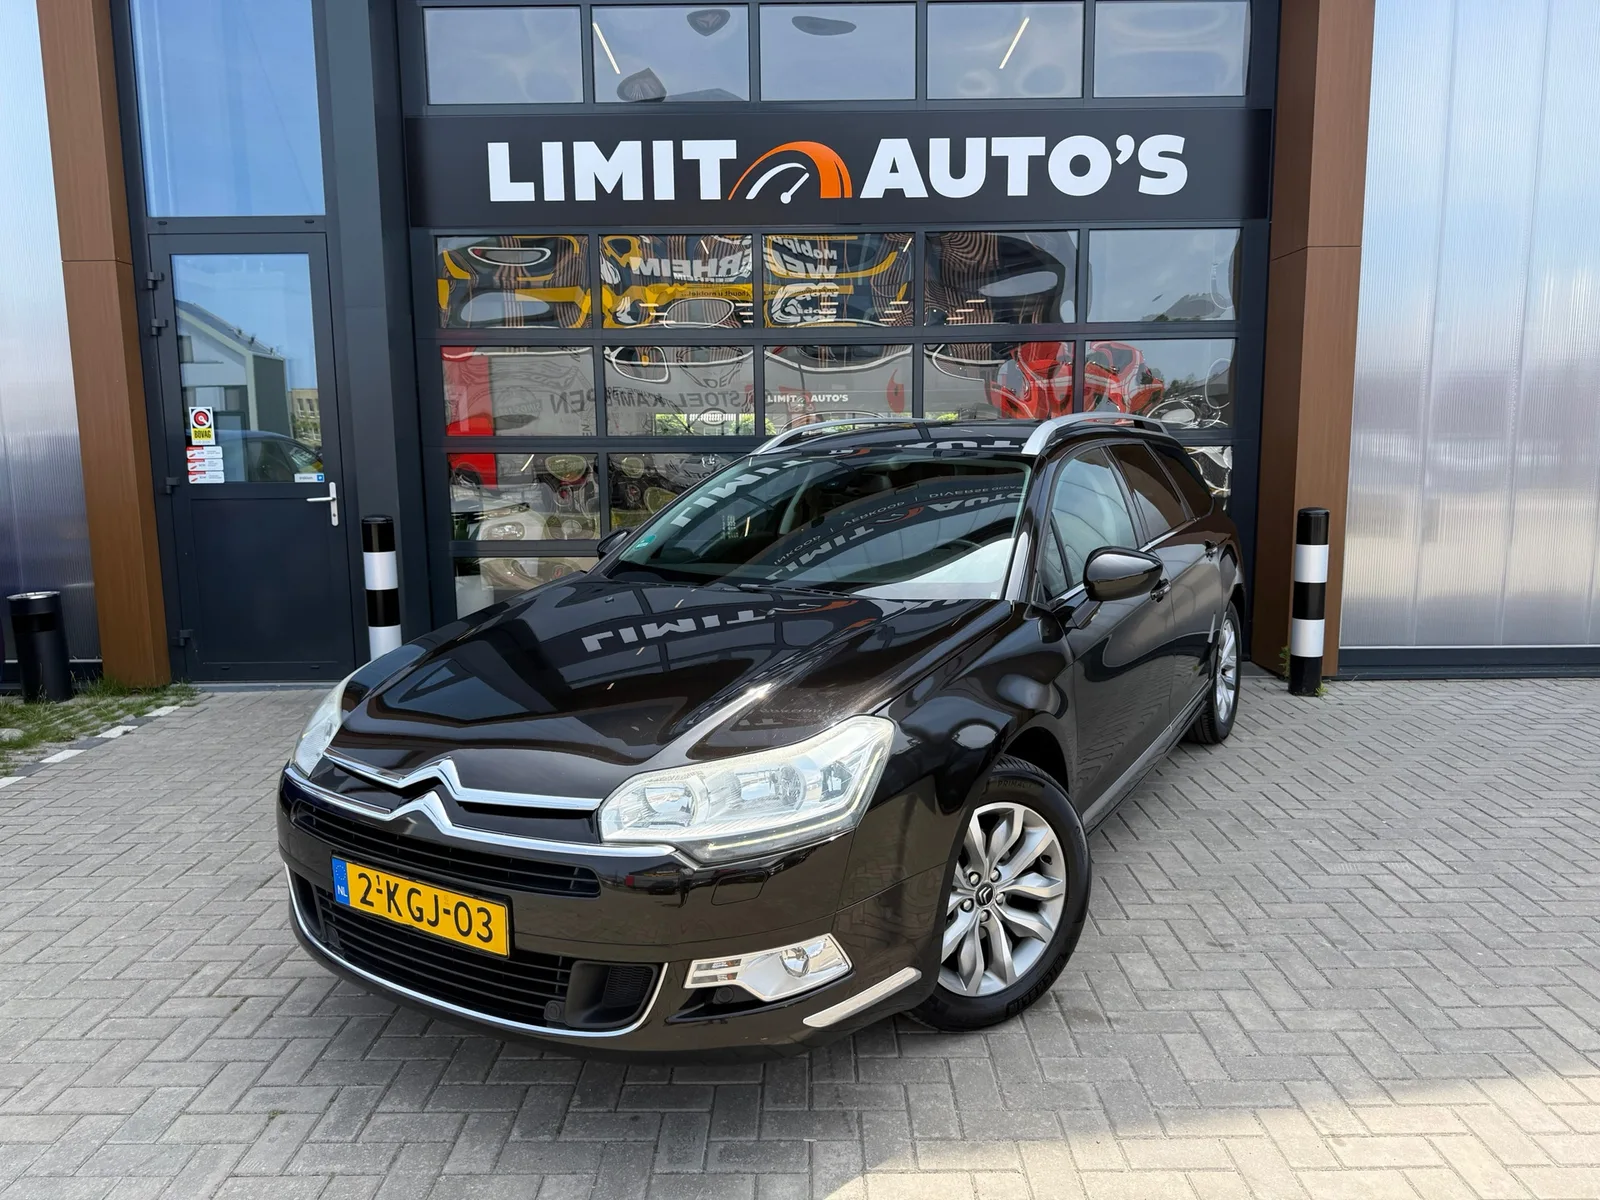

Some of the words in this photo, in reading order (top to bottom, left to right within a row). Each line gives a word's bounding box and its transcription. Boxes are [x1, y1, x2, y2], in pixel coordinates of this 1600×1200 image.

[487, 140, 737, 202] LIMIT
[860, 134, 1188, 198] AUTO'S
[767, 395, 797, 403] LIMIT
[810, 394, 849, 402] AUTO'S
[194, 430, 212, 439] BOVAG
[337, 884, 348, 898] NL
